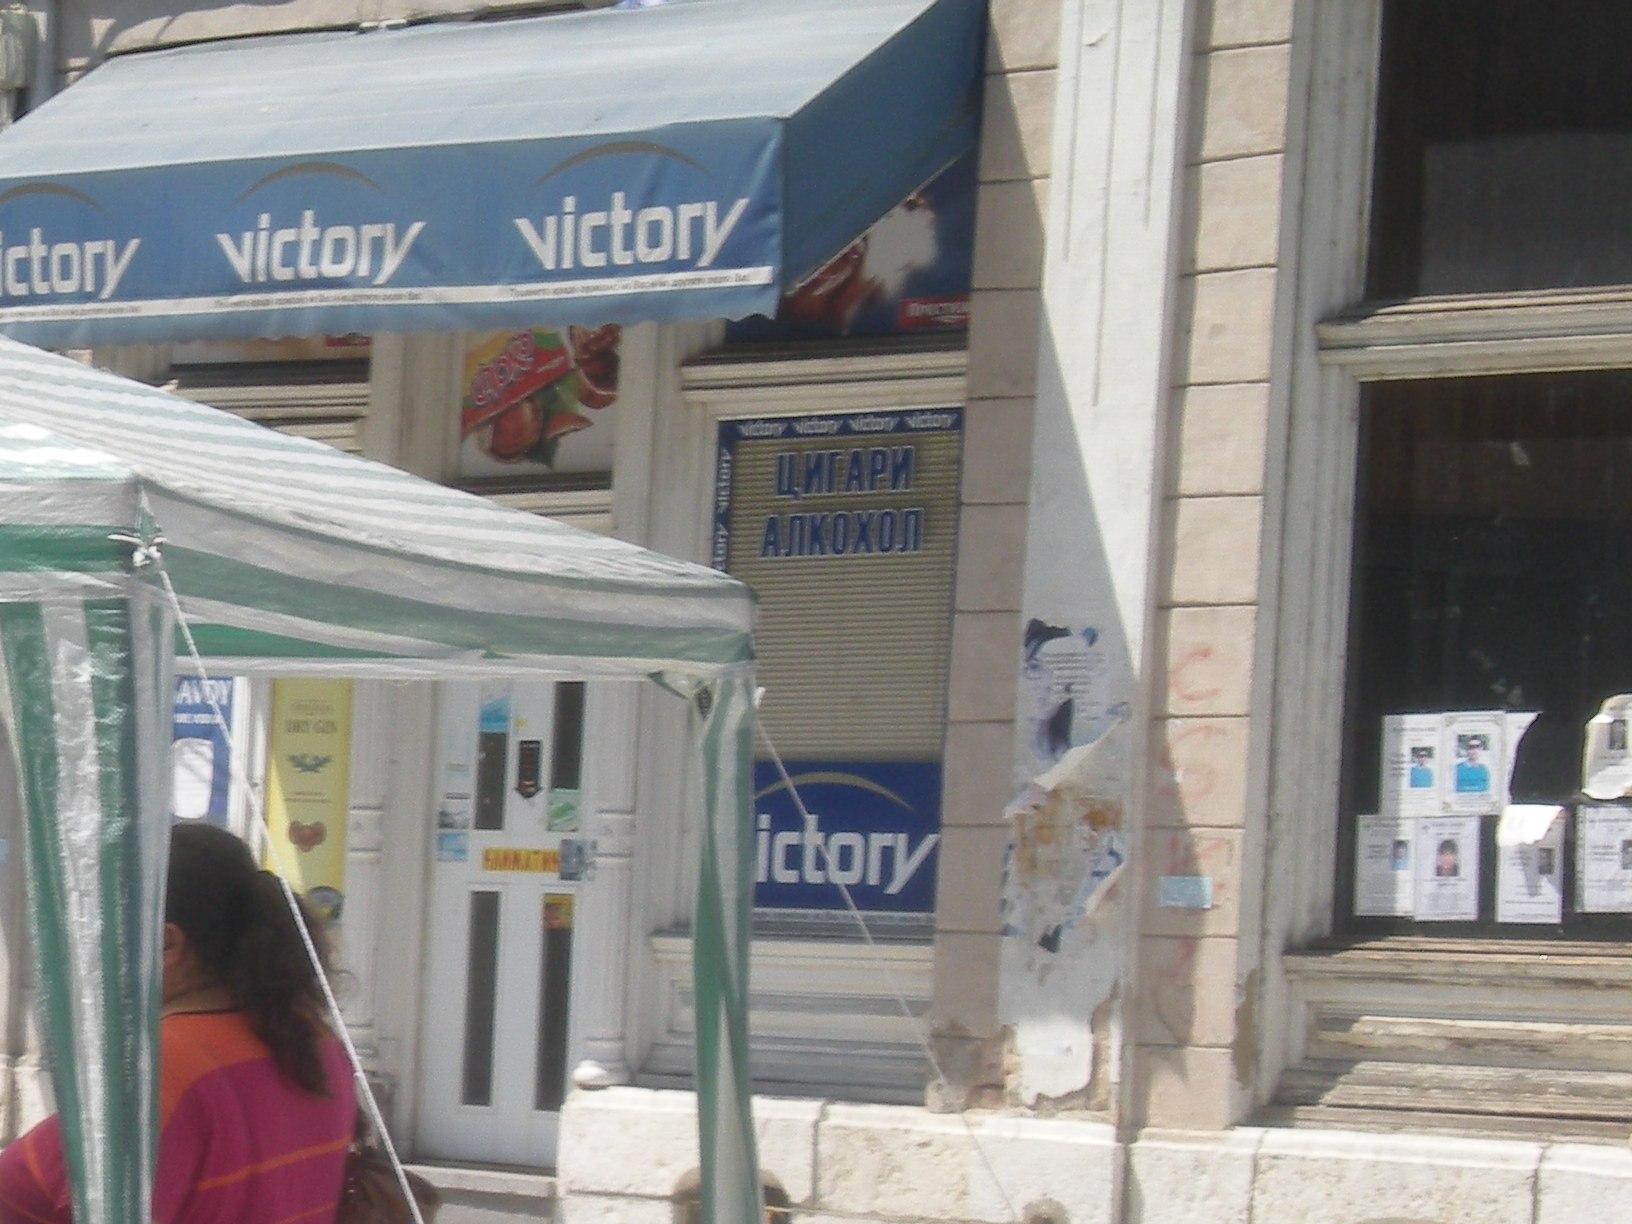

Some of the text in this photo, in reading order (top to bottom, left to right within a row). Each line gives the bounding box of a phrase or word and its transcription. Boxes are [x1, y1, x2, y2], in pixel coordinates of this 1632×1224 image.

[216, 209, 426, 285] victory
[514, 191, 750, 271] victory
[776, 446, 915, 500] ЦИГАРИ
[759, 508, 924, 560] АЛКОХОЛ
[755, 813, 940, 895] ictory
